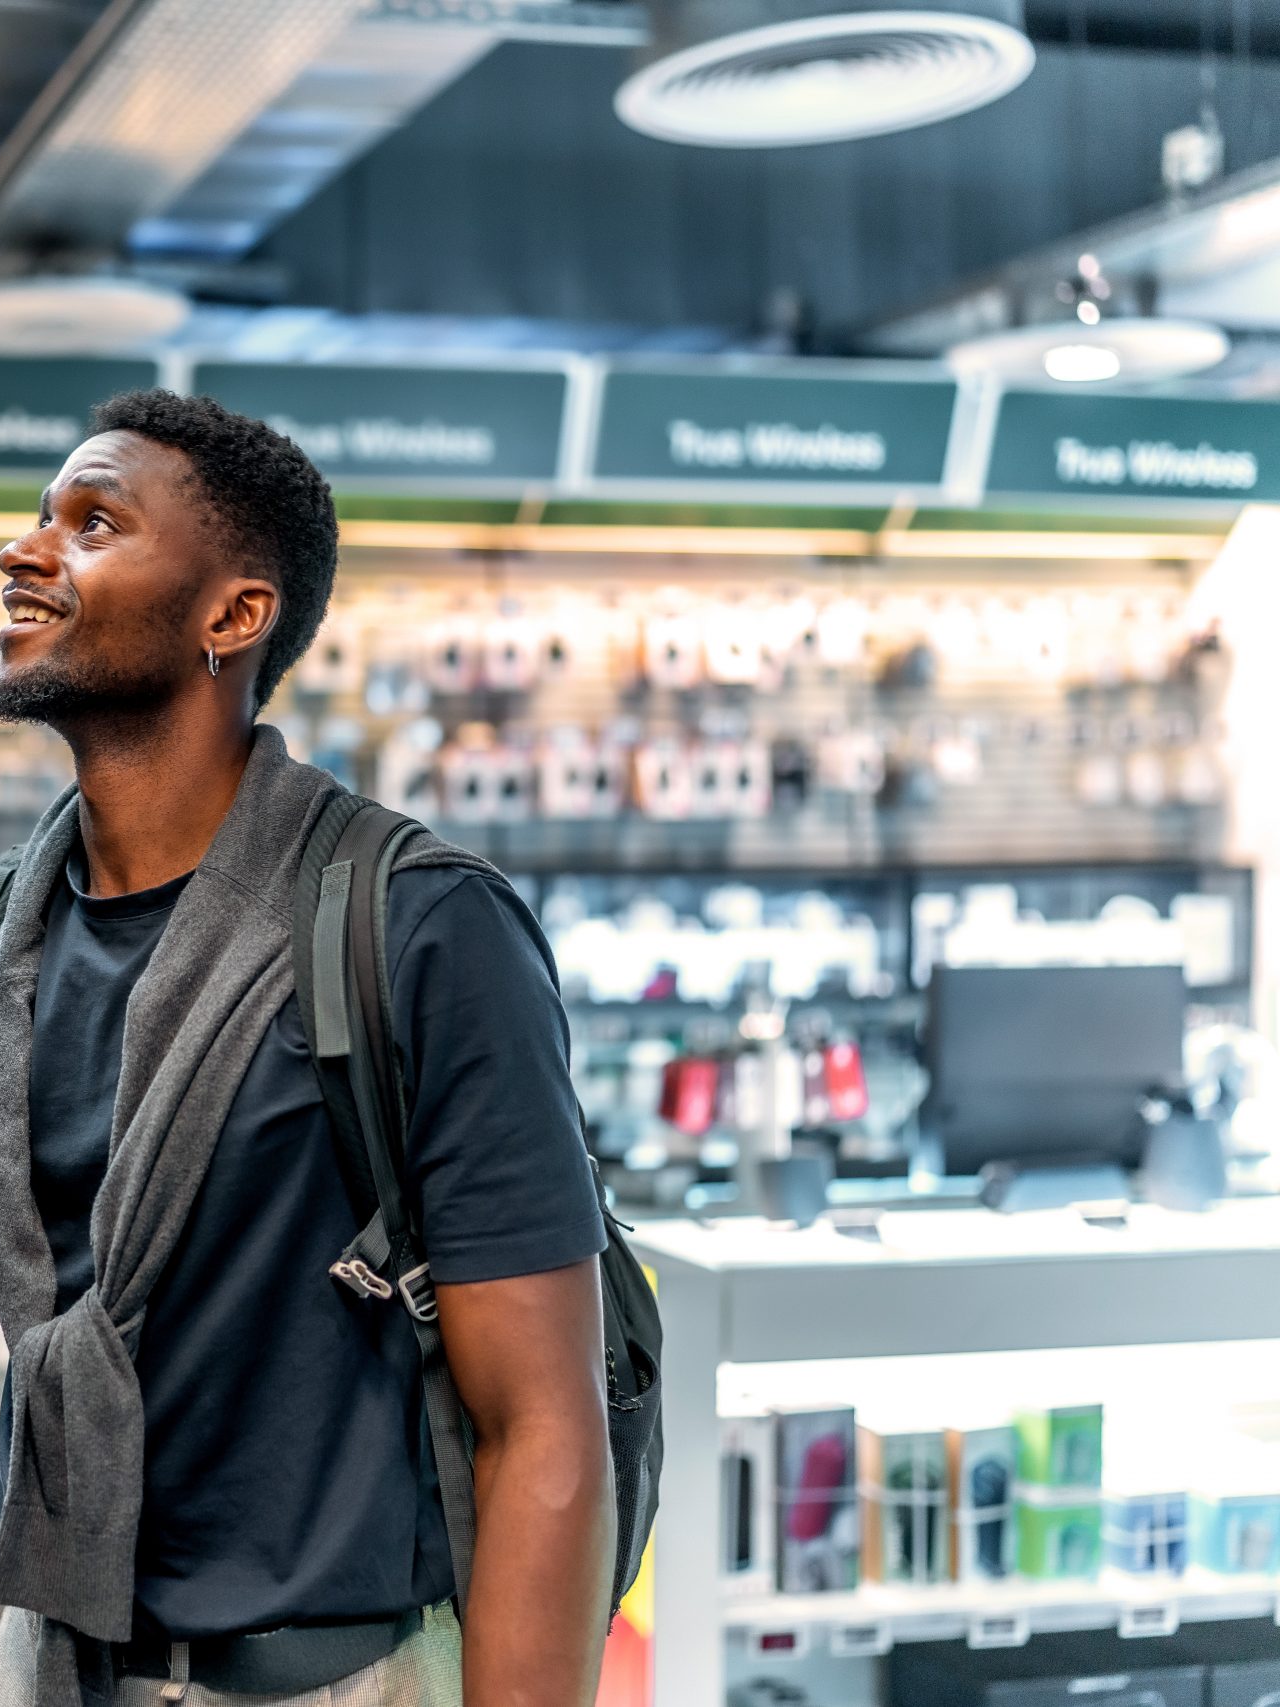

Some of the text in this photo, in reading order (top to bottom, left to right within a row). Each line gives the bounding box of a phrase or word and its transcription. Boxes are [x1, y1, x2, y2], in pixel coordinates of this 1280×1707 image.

[344, 418, 494, 463] Wireless
[668, 420, 885, 470] True Wireless
[1055, 438, 1258, 489] True Wireless
